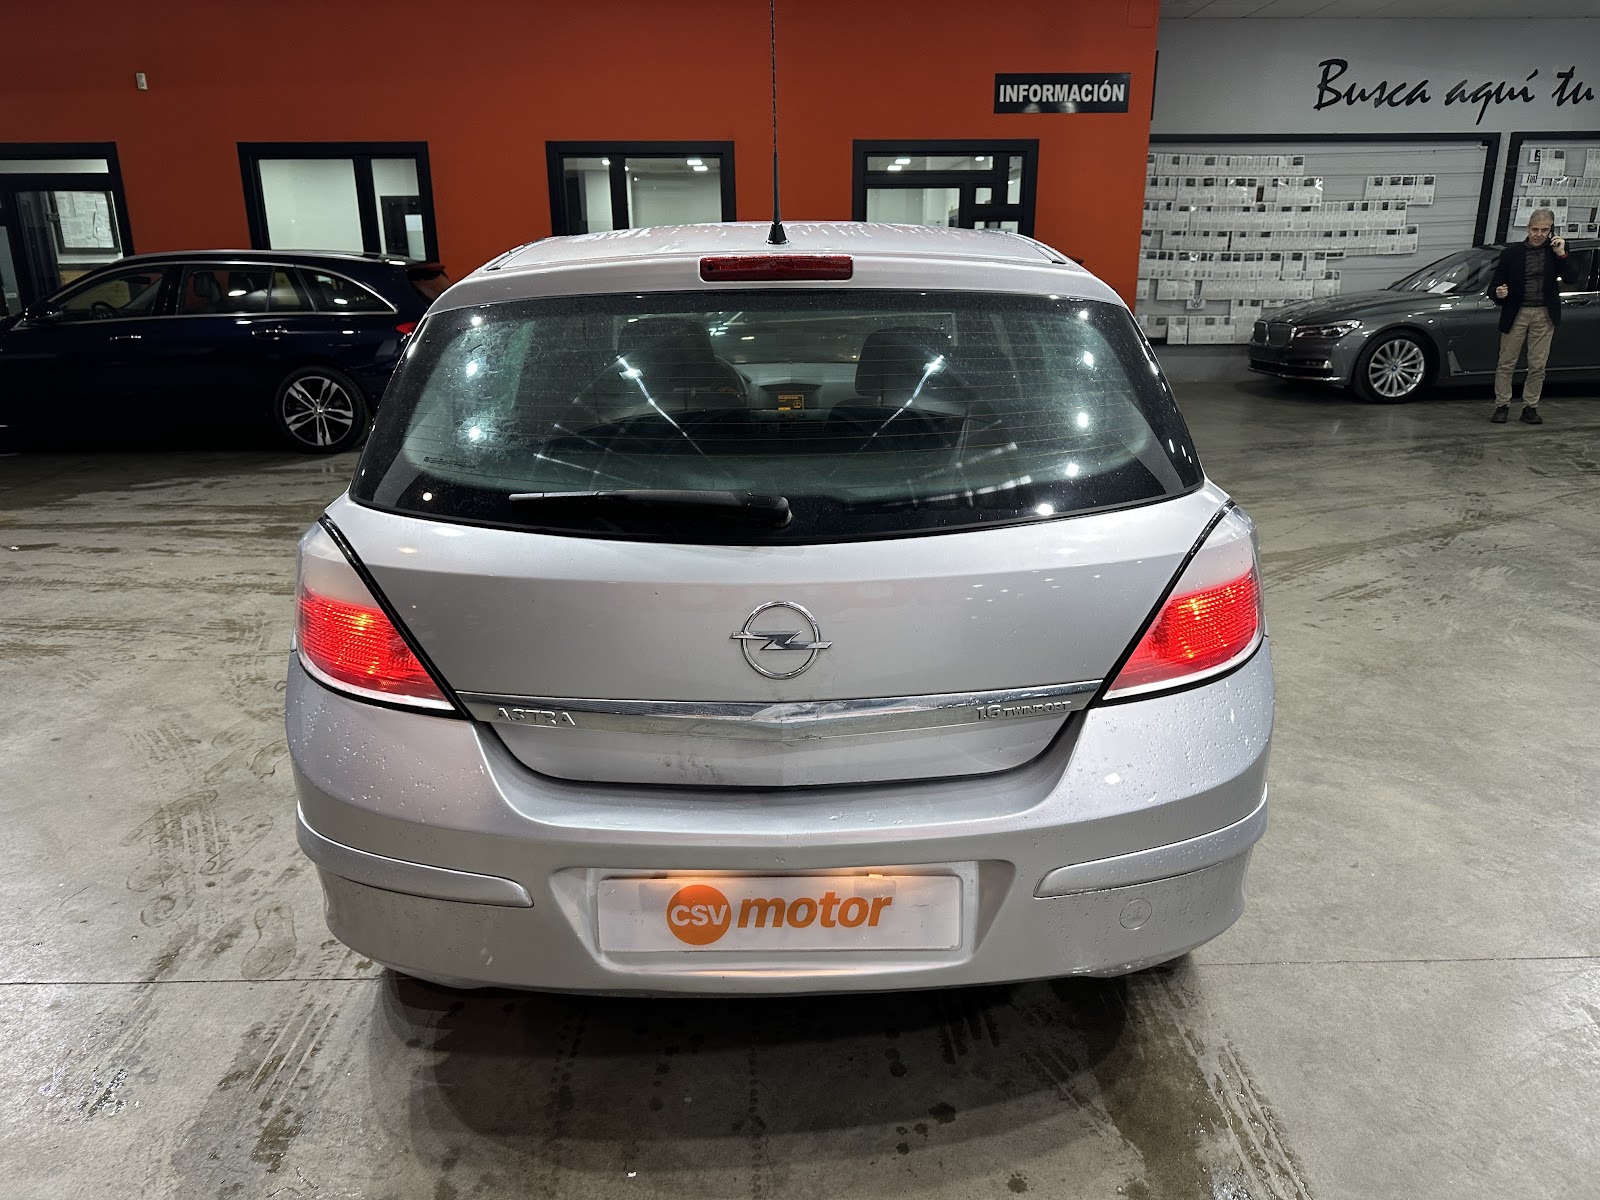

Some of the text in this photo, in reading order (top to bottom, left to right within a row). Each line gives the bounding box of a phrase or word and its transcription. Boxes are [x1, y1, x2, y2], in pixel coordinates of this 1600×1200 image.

[999, 79, 1125, 103] INFORMACIÓN
[1313, 58, 1595, 126] Busca aquí tu
[497, 707, 576, 726] ASTRA
[1002, 700, 1072, 717] TWINPORT
[737, 891, 893, 929] motor
